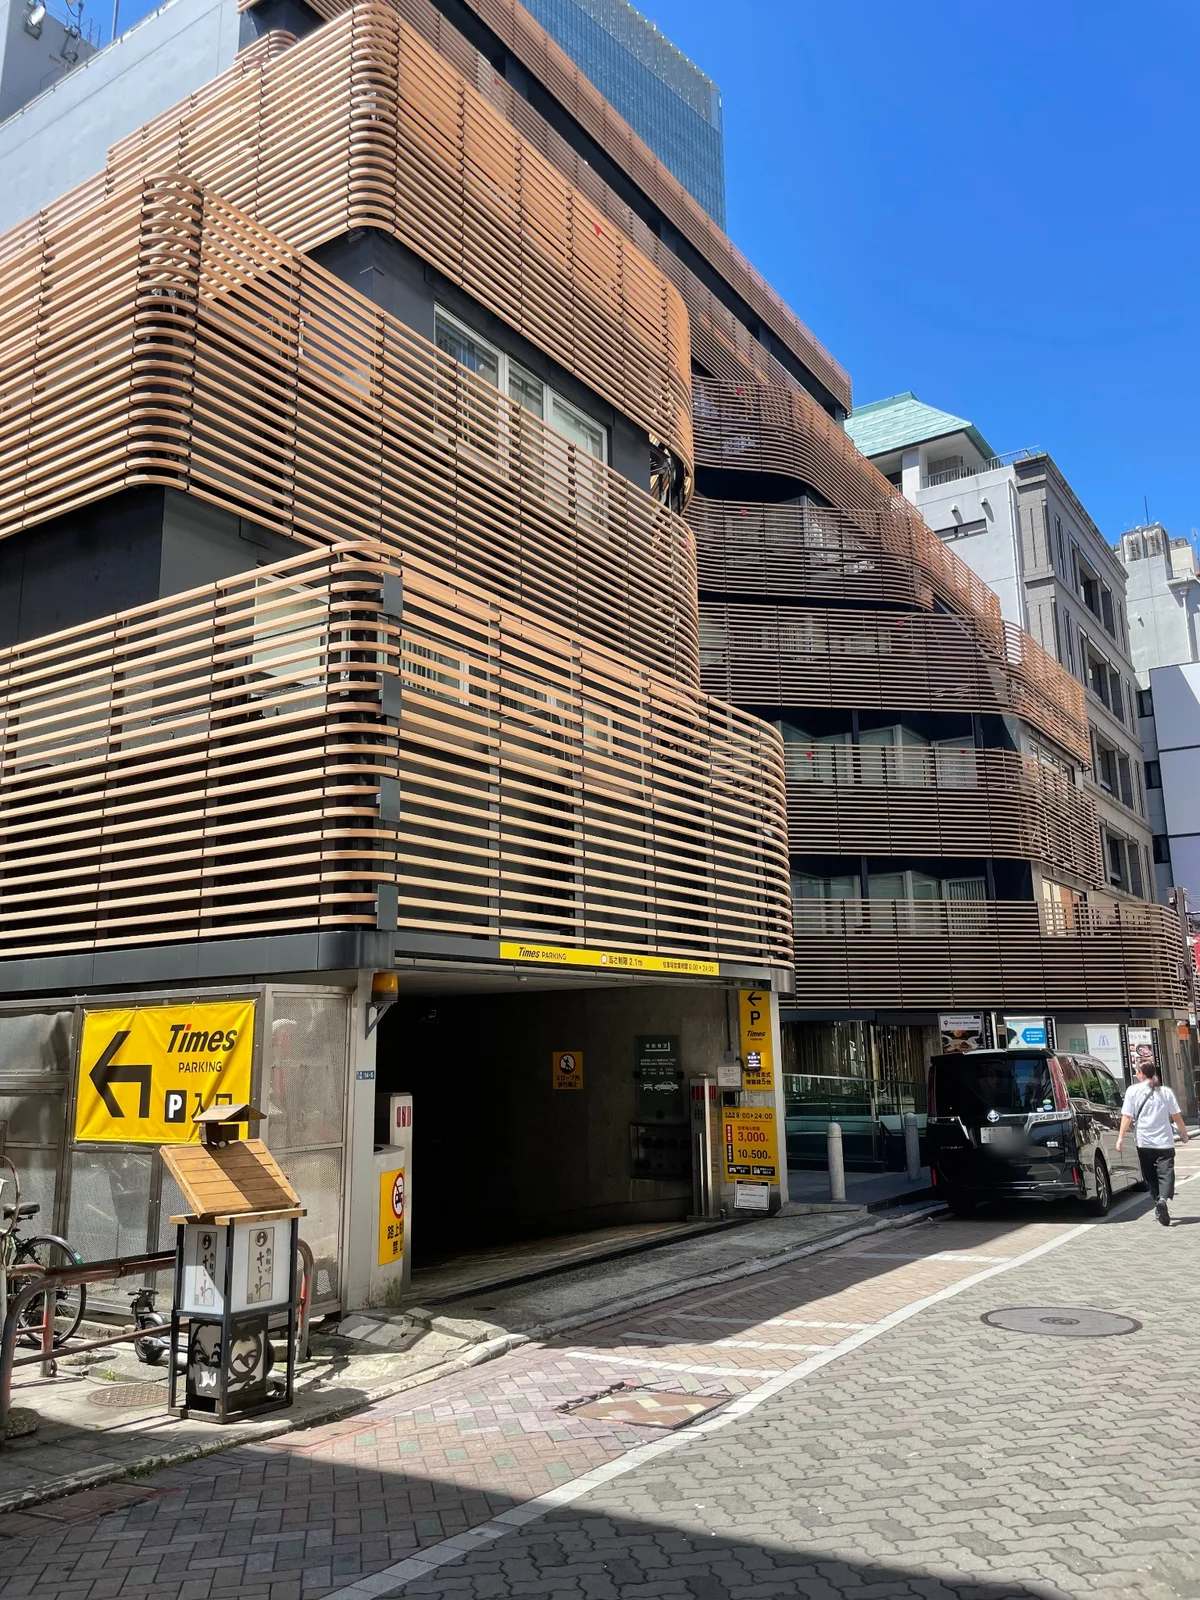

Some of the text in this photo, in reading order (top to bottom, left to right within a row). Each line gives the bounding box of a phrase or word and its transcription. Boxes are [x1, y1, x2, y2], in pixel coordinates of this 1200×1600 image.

[518, 946, 567, 960] Times PARKING
[608, 955, 644, 967] 高さ制限 2.1m
[749, 1010, 761, 1026] P
[166, 1023, 238, 1053] Times
[746, 1030, 766, 1038] Times
[178, 1060, 223, 1074] PARKING
[754, 1112, 773, 1120] 24:00
